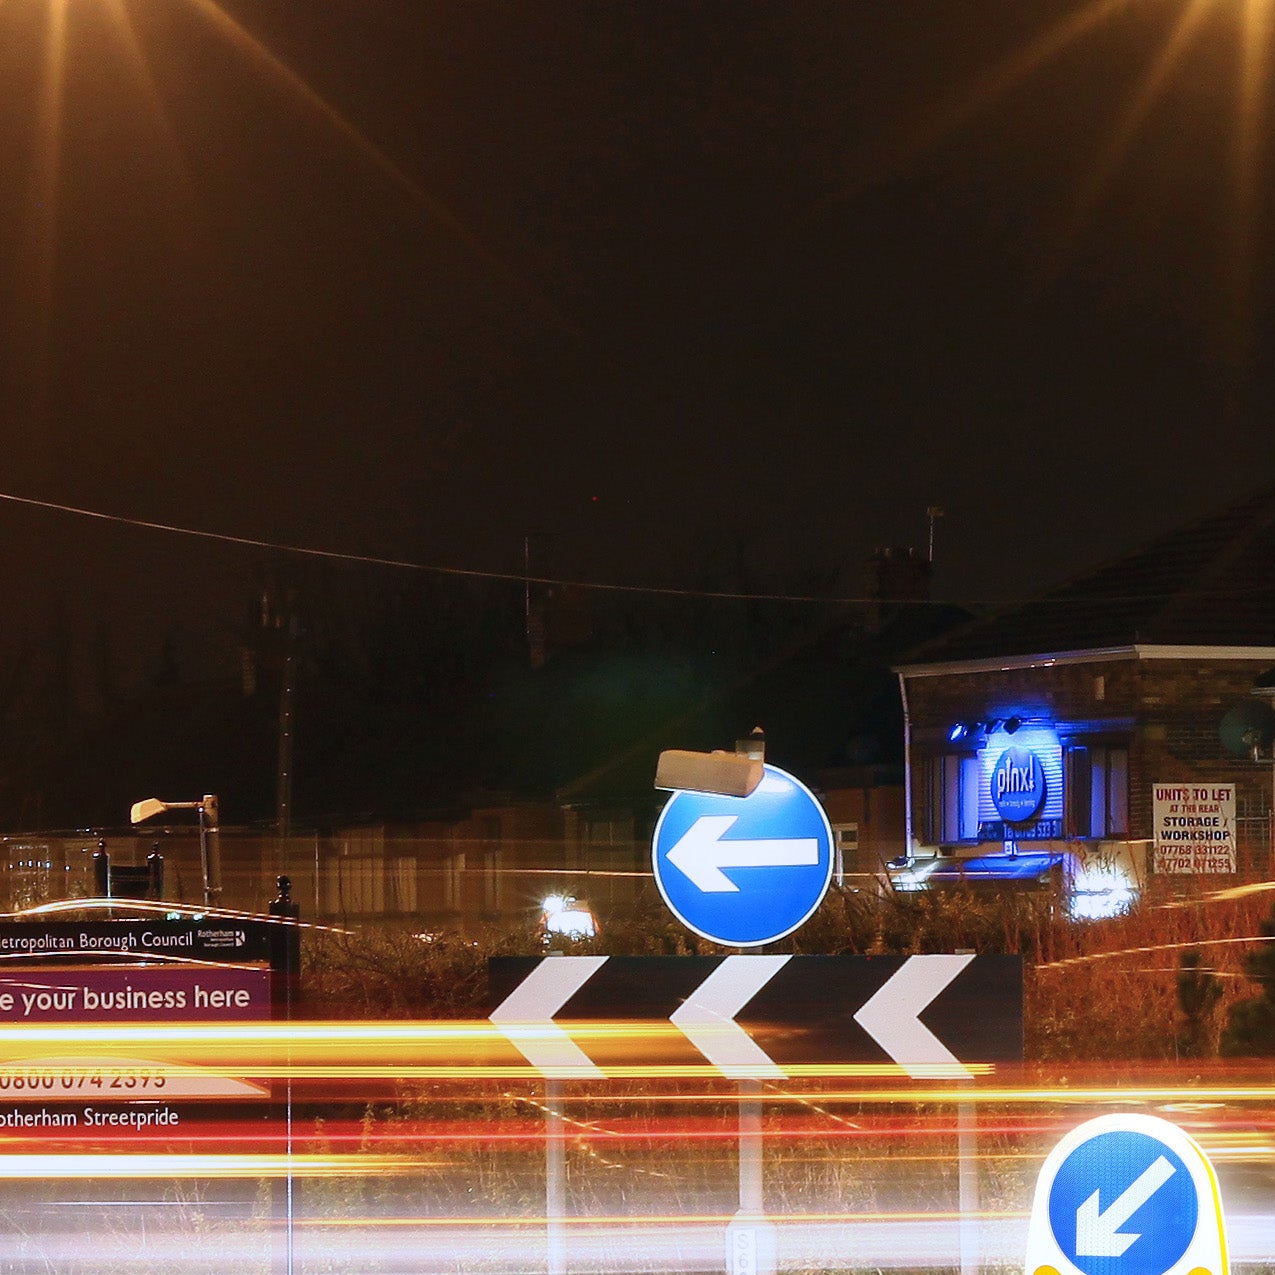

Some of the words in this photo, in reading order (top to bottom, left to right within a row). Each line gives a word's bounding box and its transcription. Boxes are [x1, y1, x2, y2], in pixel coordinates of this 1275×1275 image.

[1156, 788, 1190, 801] UNITS
[1193, 788, 1208, 801] TO
[1212, 788, 1232, 801] LET
[1169, 804, 1178, 813] AT
[1182, 804, 1197, 813] THE
[1198, 804, 1219, 813] REAR
[1163, 816, 1219, 827] STORAGE
[1161, 830, 1231, 841] WORKSHOP
[0, 933, 74, 953] etropolitan
[79, 932, 137, 951] Borough
[141, 931, 193, 947] Council
[21, 992, 76, 1016] your
[83, 986, 187, 1010] business
[194, 985, 250, 1008] here
[0, 1068, 54, 1090] 0800
[61, 1068, 103, 1089] 074
[110, 1068, 166, 1089] 2395
[83, 1107, 179, 1131] Streetpride
